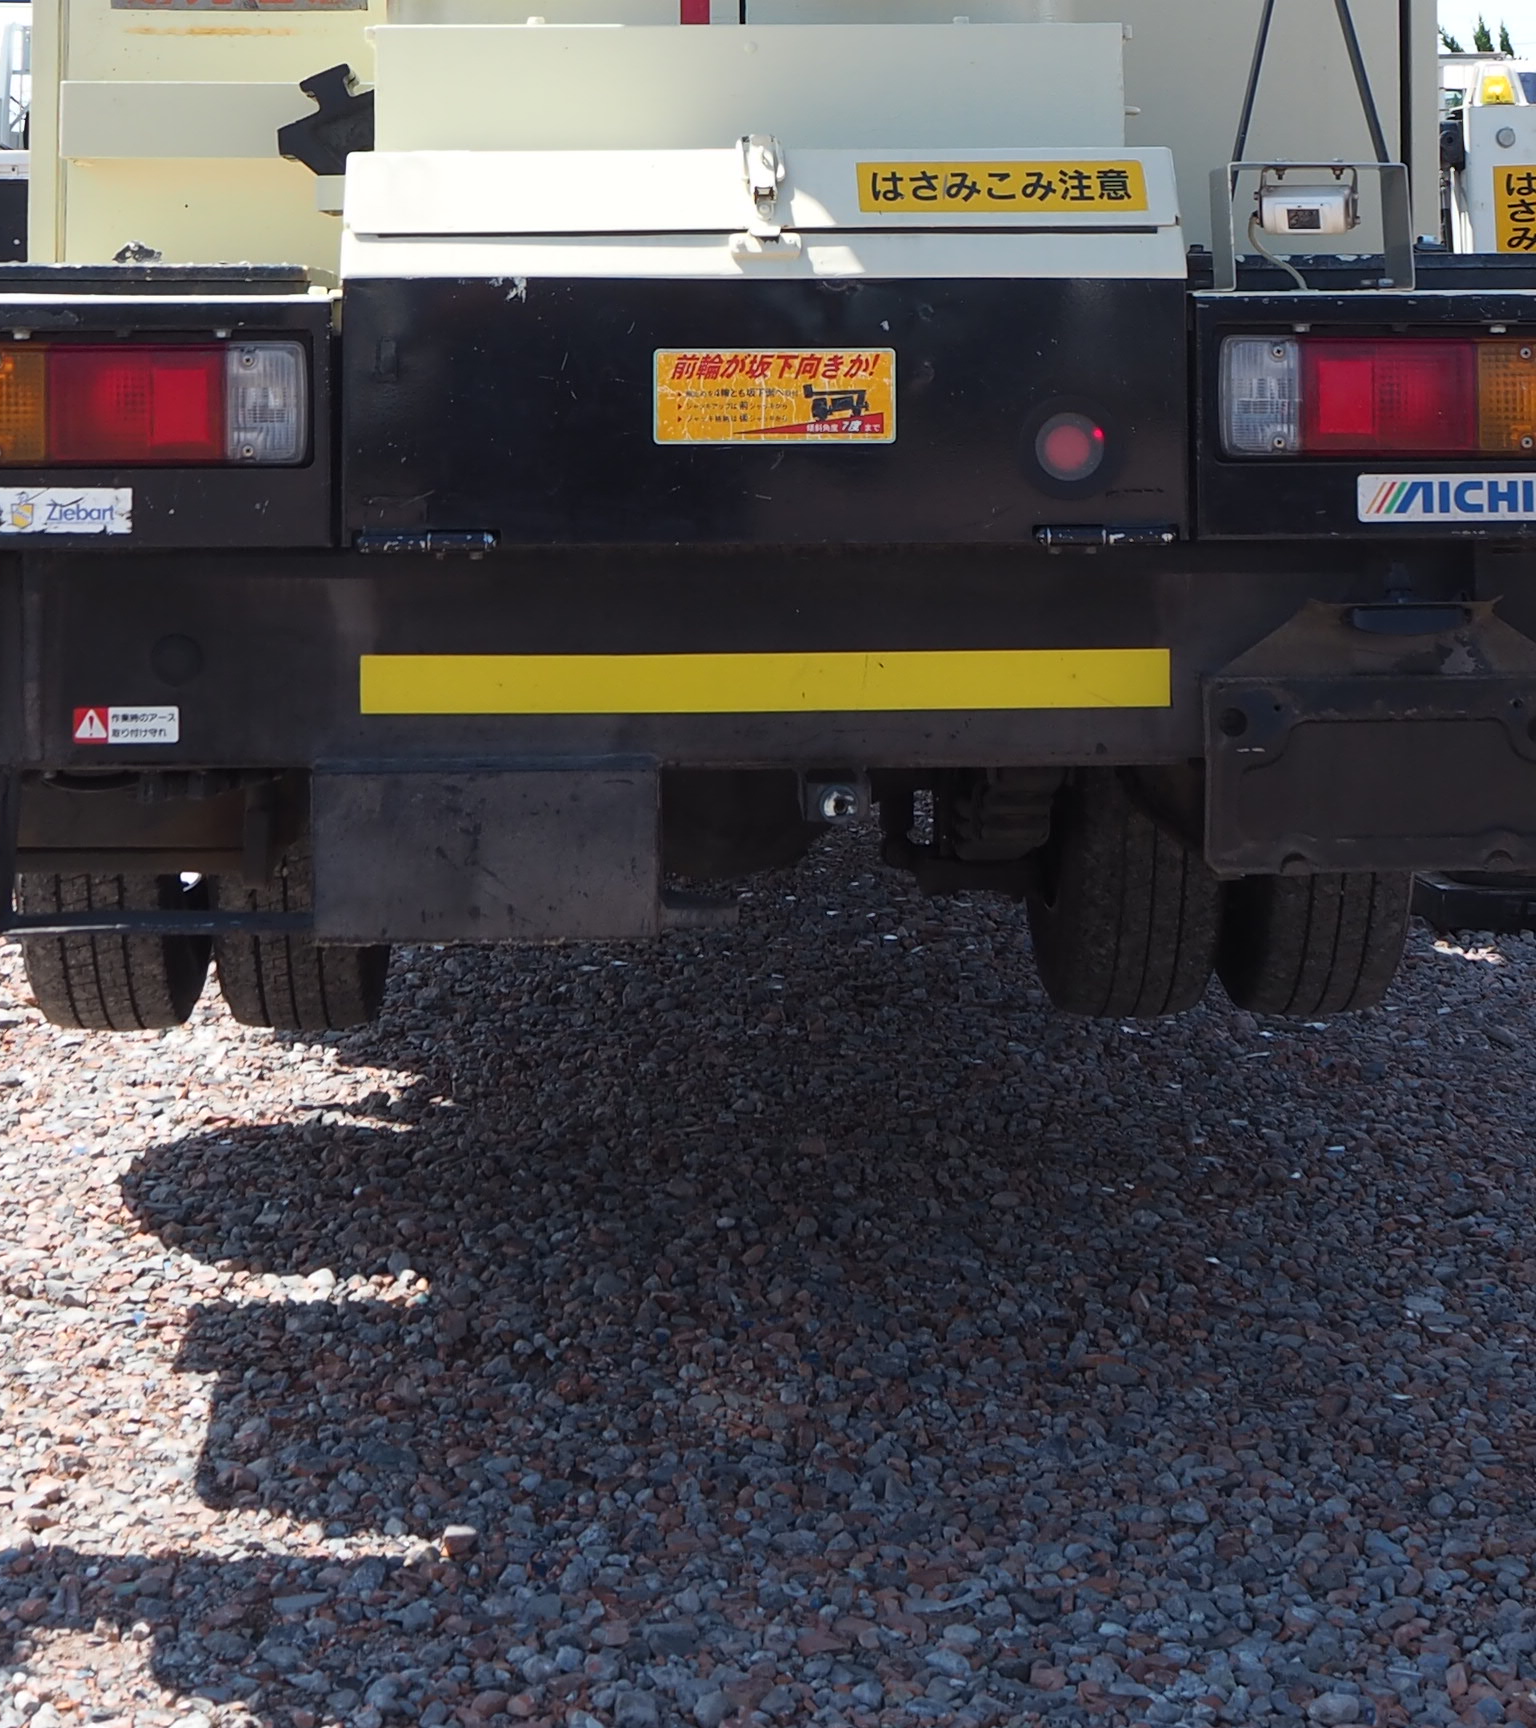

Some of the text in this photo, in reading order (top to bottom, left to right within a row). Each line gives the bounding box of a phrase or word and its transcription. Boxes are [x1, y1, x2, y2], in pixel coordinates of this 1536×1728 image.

[869, 168, 1133, 204] はさみこみ注意
[46, 502, 115, 522] Ziebart
[1396, 480, 1535, 514] AICHI
